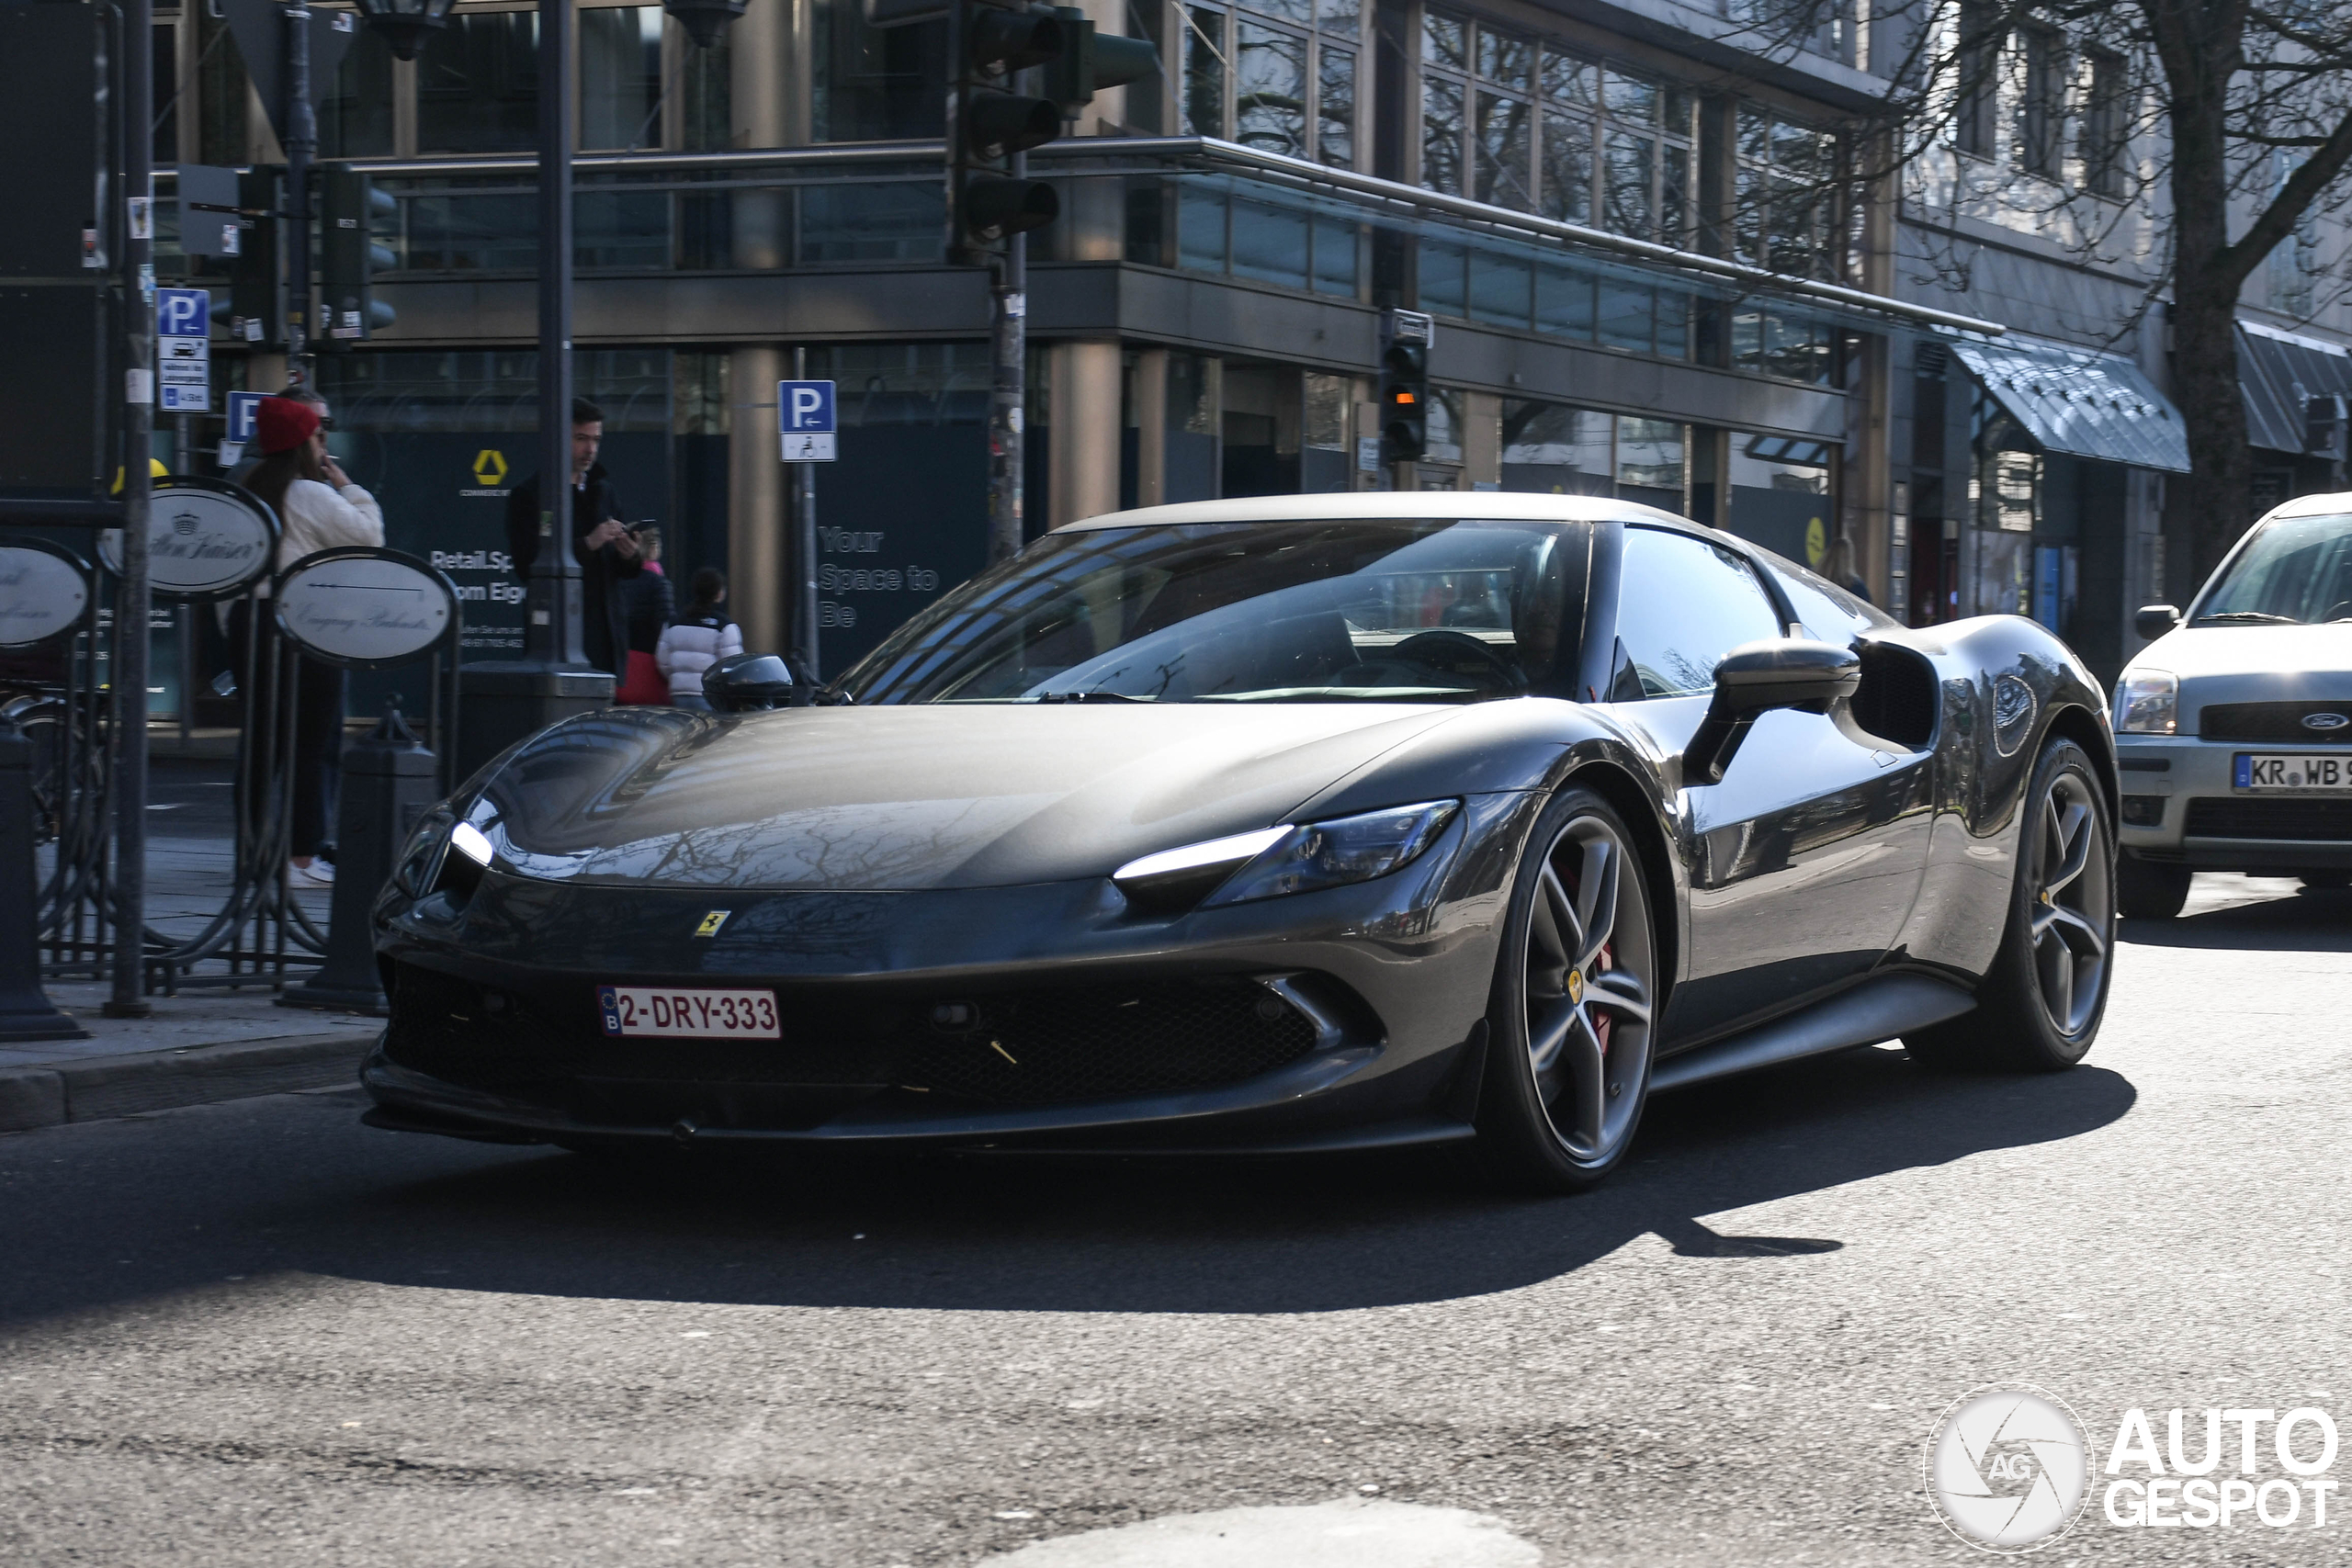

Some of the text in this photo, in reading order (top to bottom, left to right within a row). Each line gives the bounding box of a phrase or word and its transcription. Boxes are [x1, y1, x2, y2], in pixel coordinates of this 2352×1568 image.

[168, 296, 197, 333] P
[791, 388, 822, 428] P
[818, 525, 884, 553] Your
[456, 585, 486, 601] om
[818, 563, 939, 595] Space to
[819, 601, 856, 628] Be
[2252, 760, 2286, 785] KR
[2304, 760, 2340, 785] WB
[606, 1015, 618, 1030] B
[619, 995, 776, 1030] 2-DRY-333
